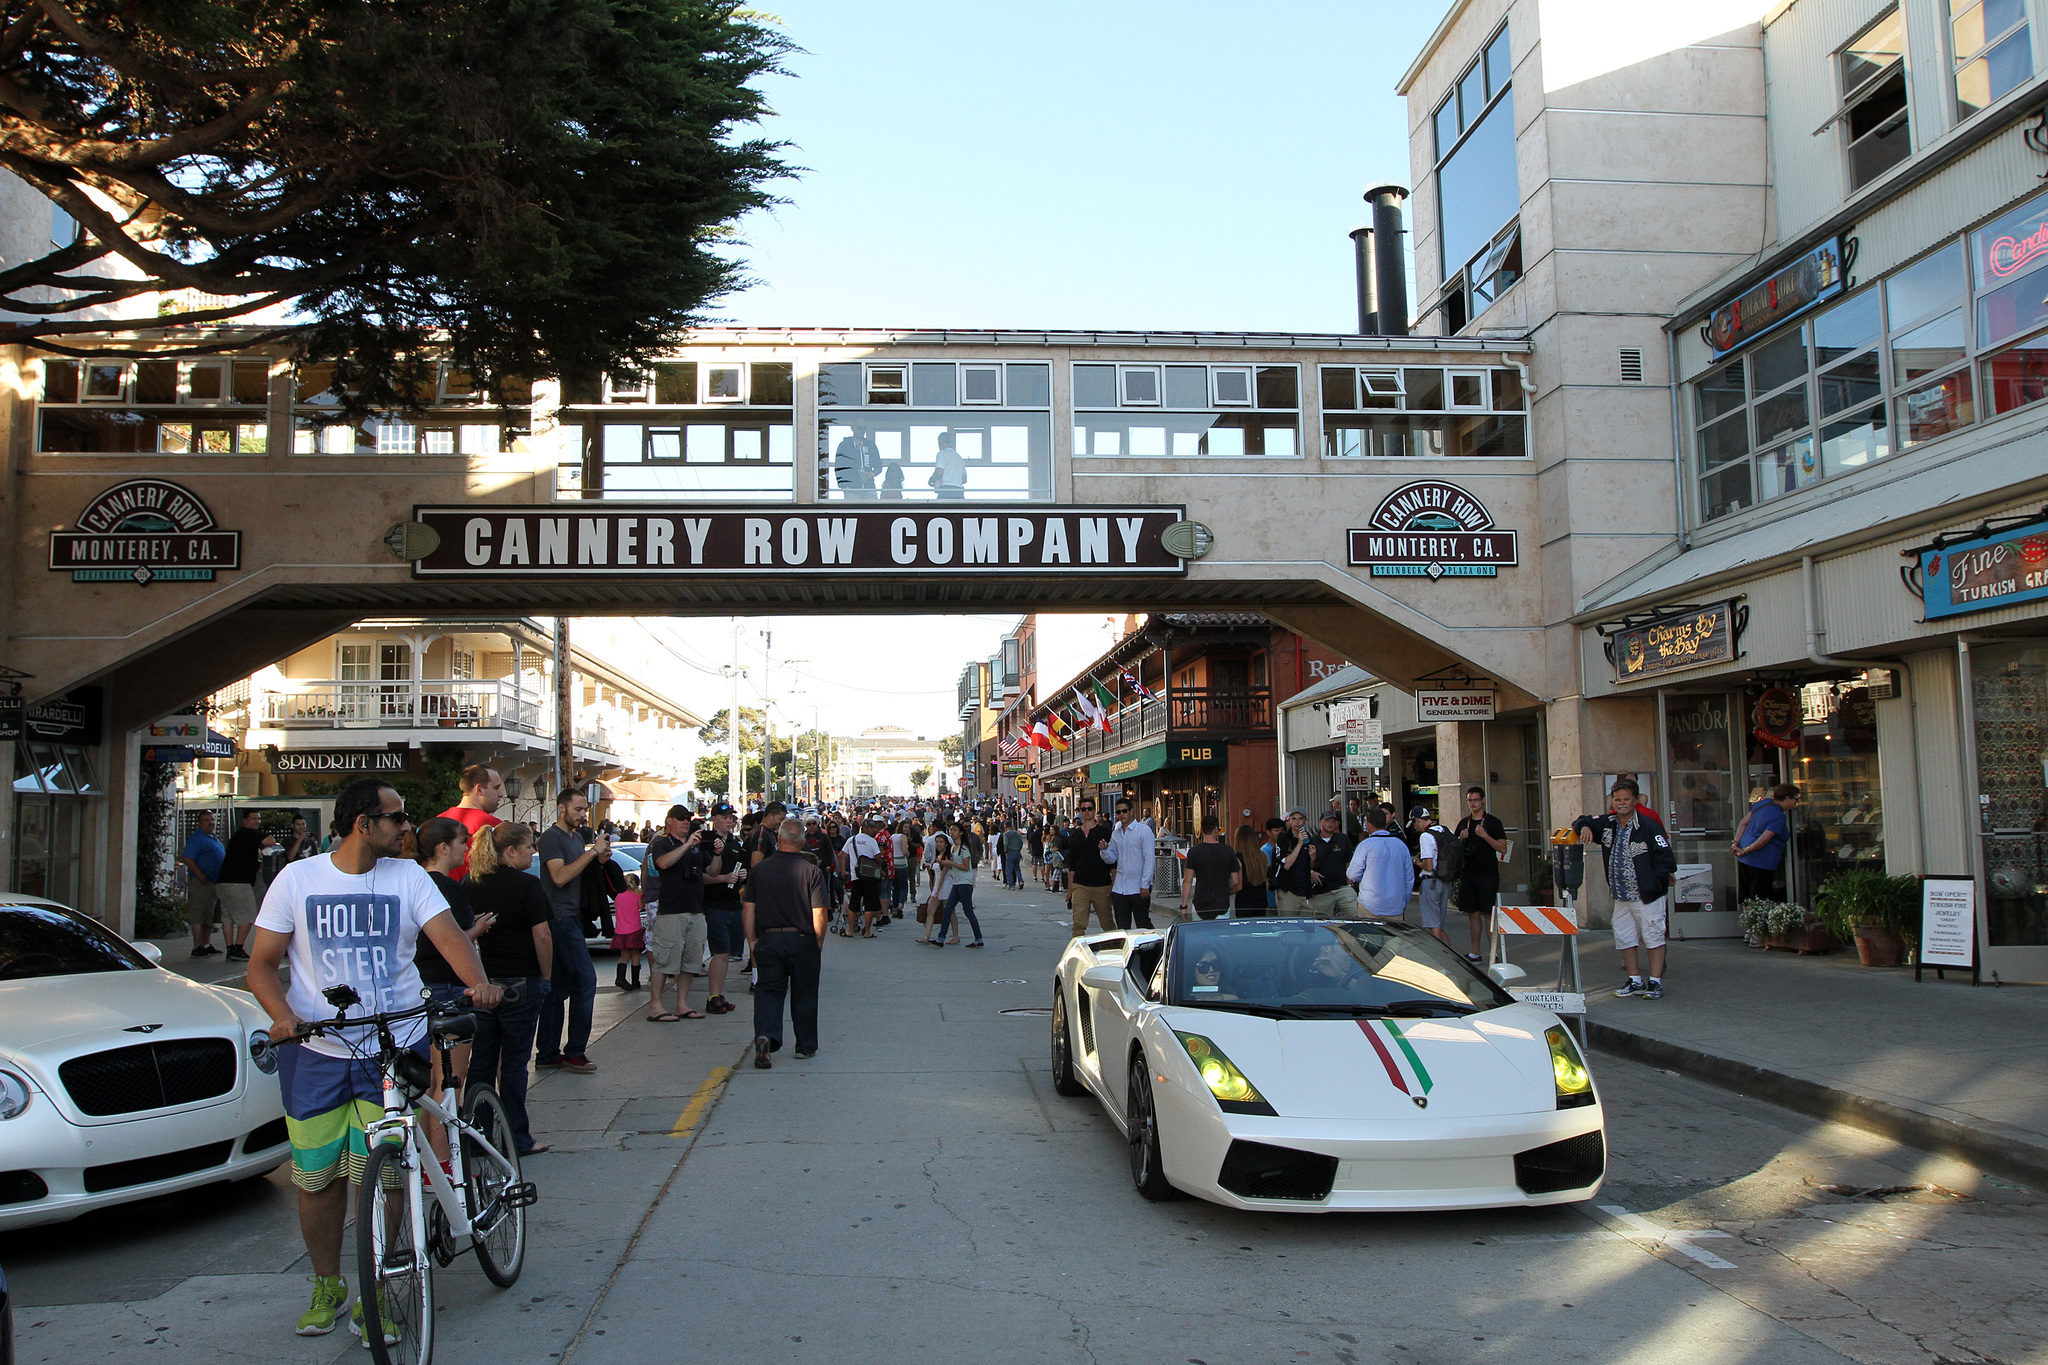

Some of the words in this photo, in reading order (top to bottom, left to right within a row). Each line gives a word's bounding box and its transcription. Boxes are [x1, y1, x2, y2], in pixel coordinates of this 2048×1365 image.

[89, 487, 168, 530] CANNERY
[166, 495, 203, 530] ROW
[1382, 487, 1451, 528] CANNERY
[1450, 495, 1485, 529] ROW
[72, 540, 178, 562] MONTEREY,
[188, 539, 218, 560] CA.
[465, 518, 711, 566] CANNERY
[744, 518, 857, 566] ROW
[890, 518, 1143, 565] COMPANY
[1369, 537, 1465, 560] MONTEREY,
[1473, 538, 1500, 558] CA.
[77, 571, 129, 580] STEINBECK
[158, 571, 186, 579] PLAZA
[191, 570, 210, 579] TWO
[1375, 567, 1422, 575] STEINBECK
[1448, 567, 1473, 575] PLAZA
[1476, 567, 1494, 575] ONE
[1952, 548, 2007, 590] Fine
[1960, 579, 2016, 602] TURKISH
[1648, 622, 1692, 647] Charms
[1696, 613, 1718, 639] By
[1659, 640, 1677, 660] the
[1675, 634, 1700, 656] Bay
[1422, 696, 1449, 706] FIVE
[1450, 696, 1459, 705] &
[1461, 696, 1491, 706] DIME
[149, 723, 199, 737] tervis
[278, 753, 369, 770] SPINDRIFT
[375, 753, 403, 769] INN
[1180, 748, 1212, 761] PUB
[1350, 746, 1356, 754] 2
[1350, 768, 1358, 776] &
[316, 904, 391, 939] HOLLI
[321, 945, 389, 983] STER
[1524, 994, 1565, 1003] MONTEREY
